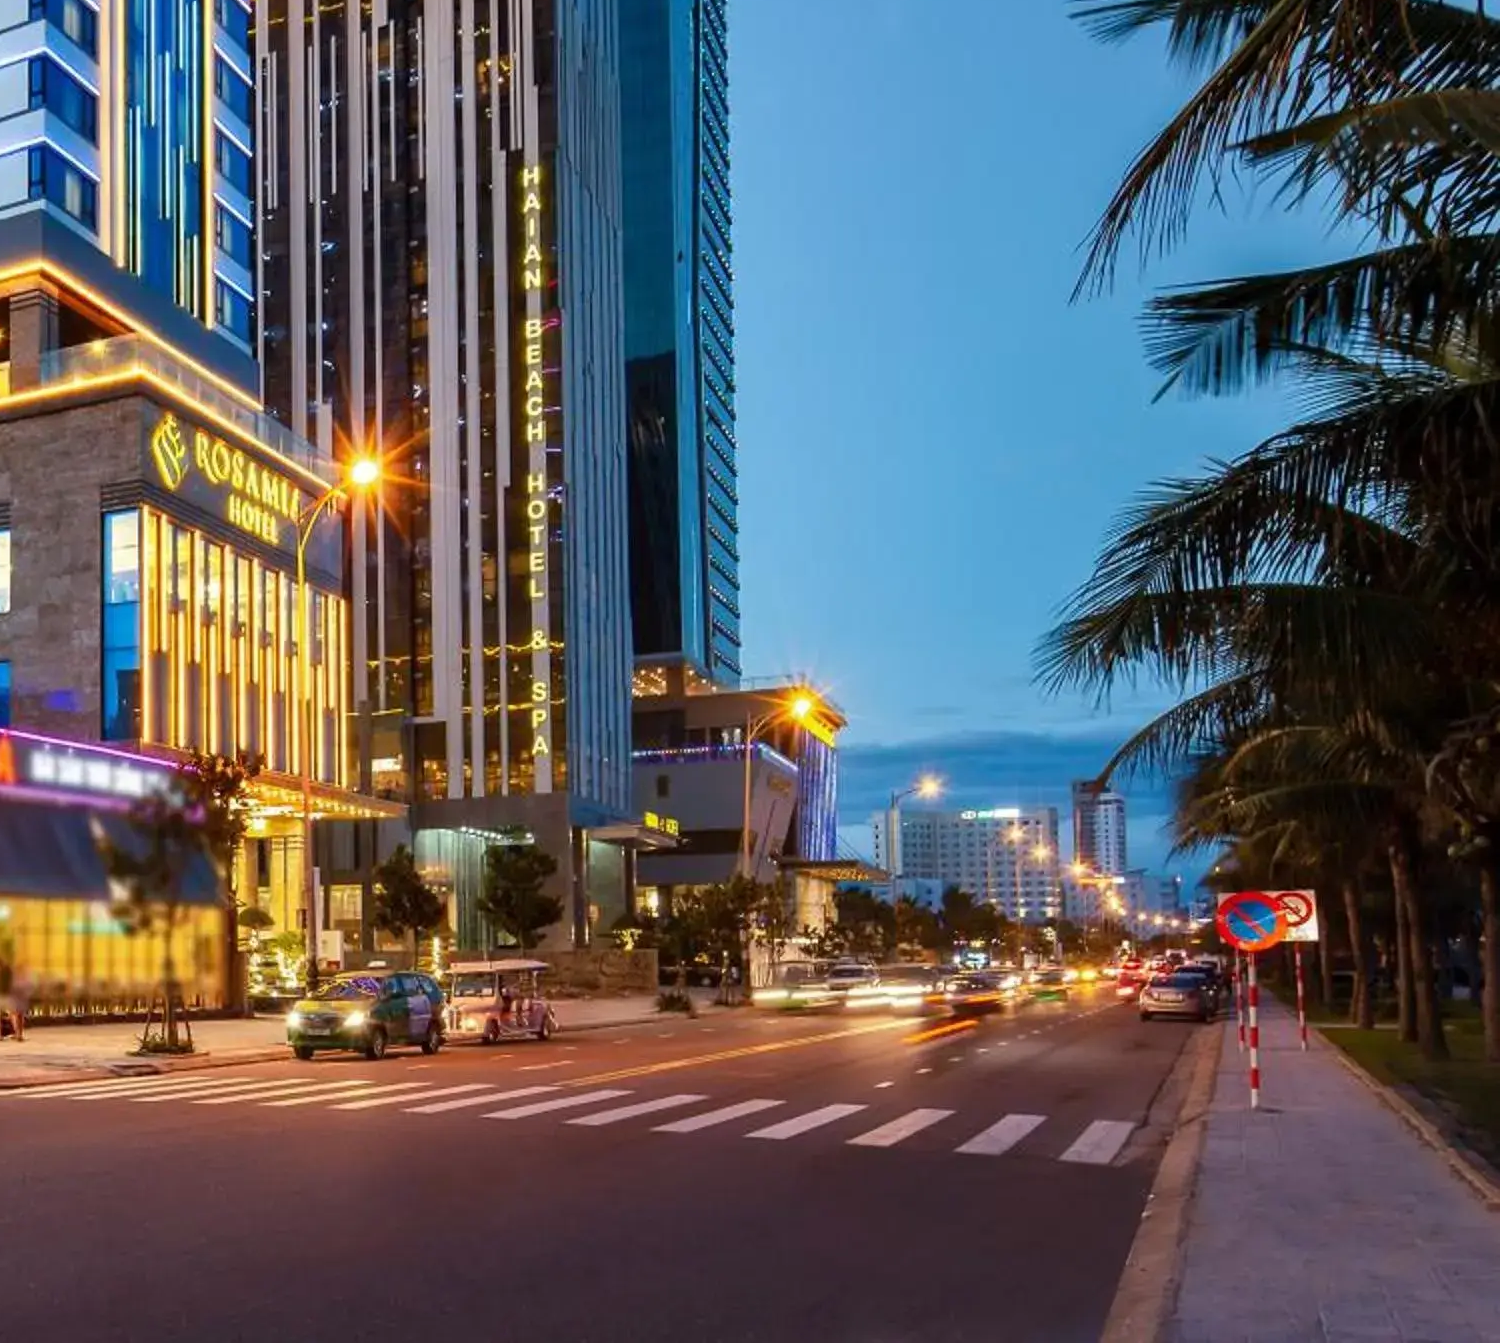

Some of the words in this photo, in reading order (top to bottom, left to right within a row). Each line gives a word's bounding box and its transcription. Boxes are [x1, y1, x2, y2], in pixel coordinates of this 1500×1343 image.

[523, 167, 541, 289] HAIAN
[525, 319, 543, 441] BEACH
[194, 431, 301, 523] ROSAMIA
[228, 493, 279, 545] HOTEL
[527, 474, 545, 598] HOTEL
[531, 630, 547, 650] &
[531, 682, 549, 755] SPA
